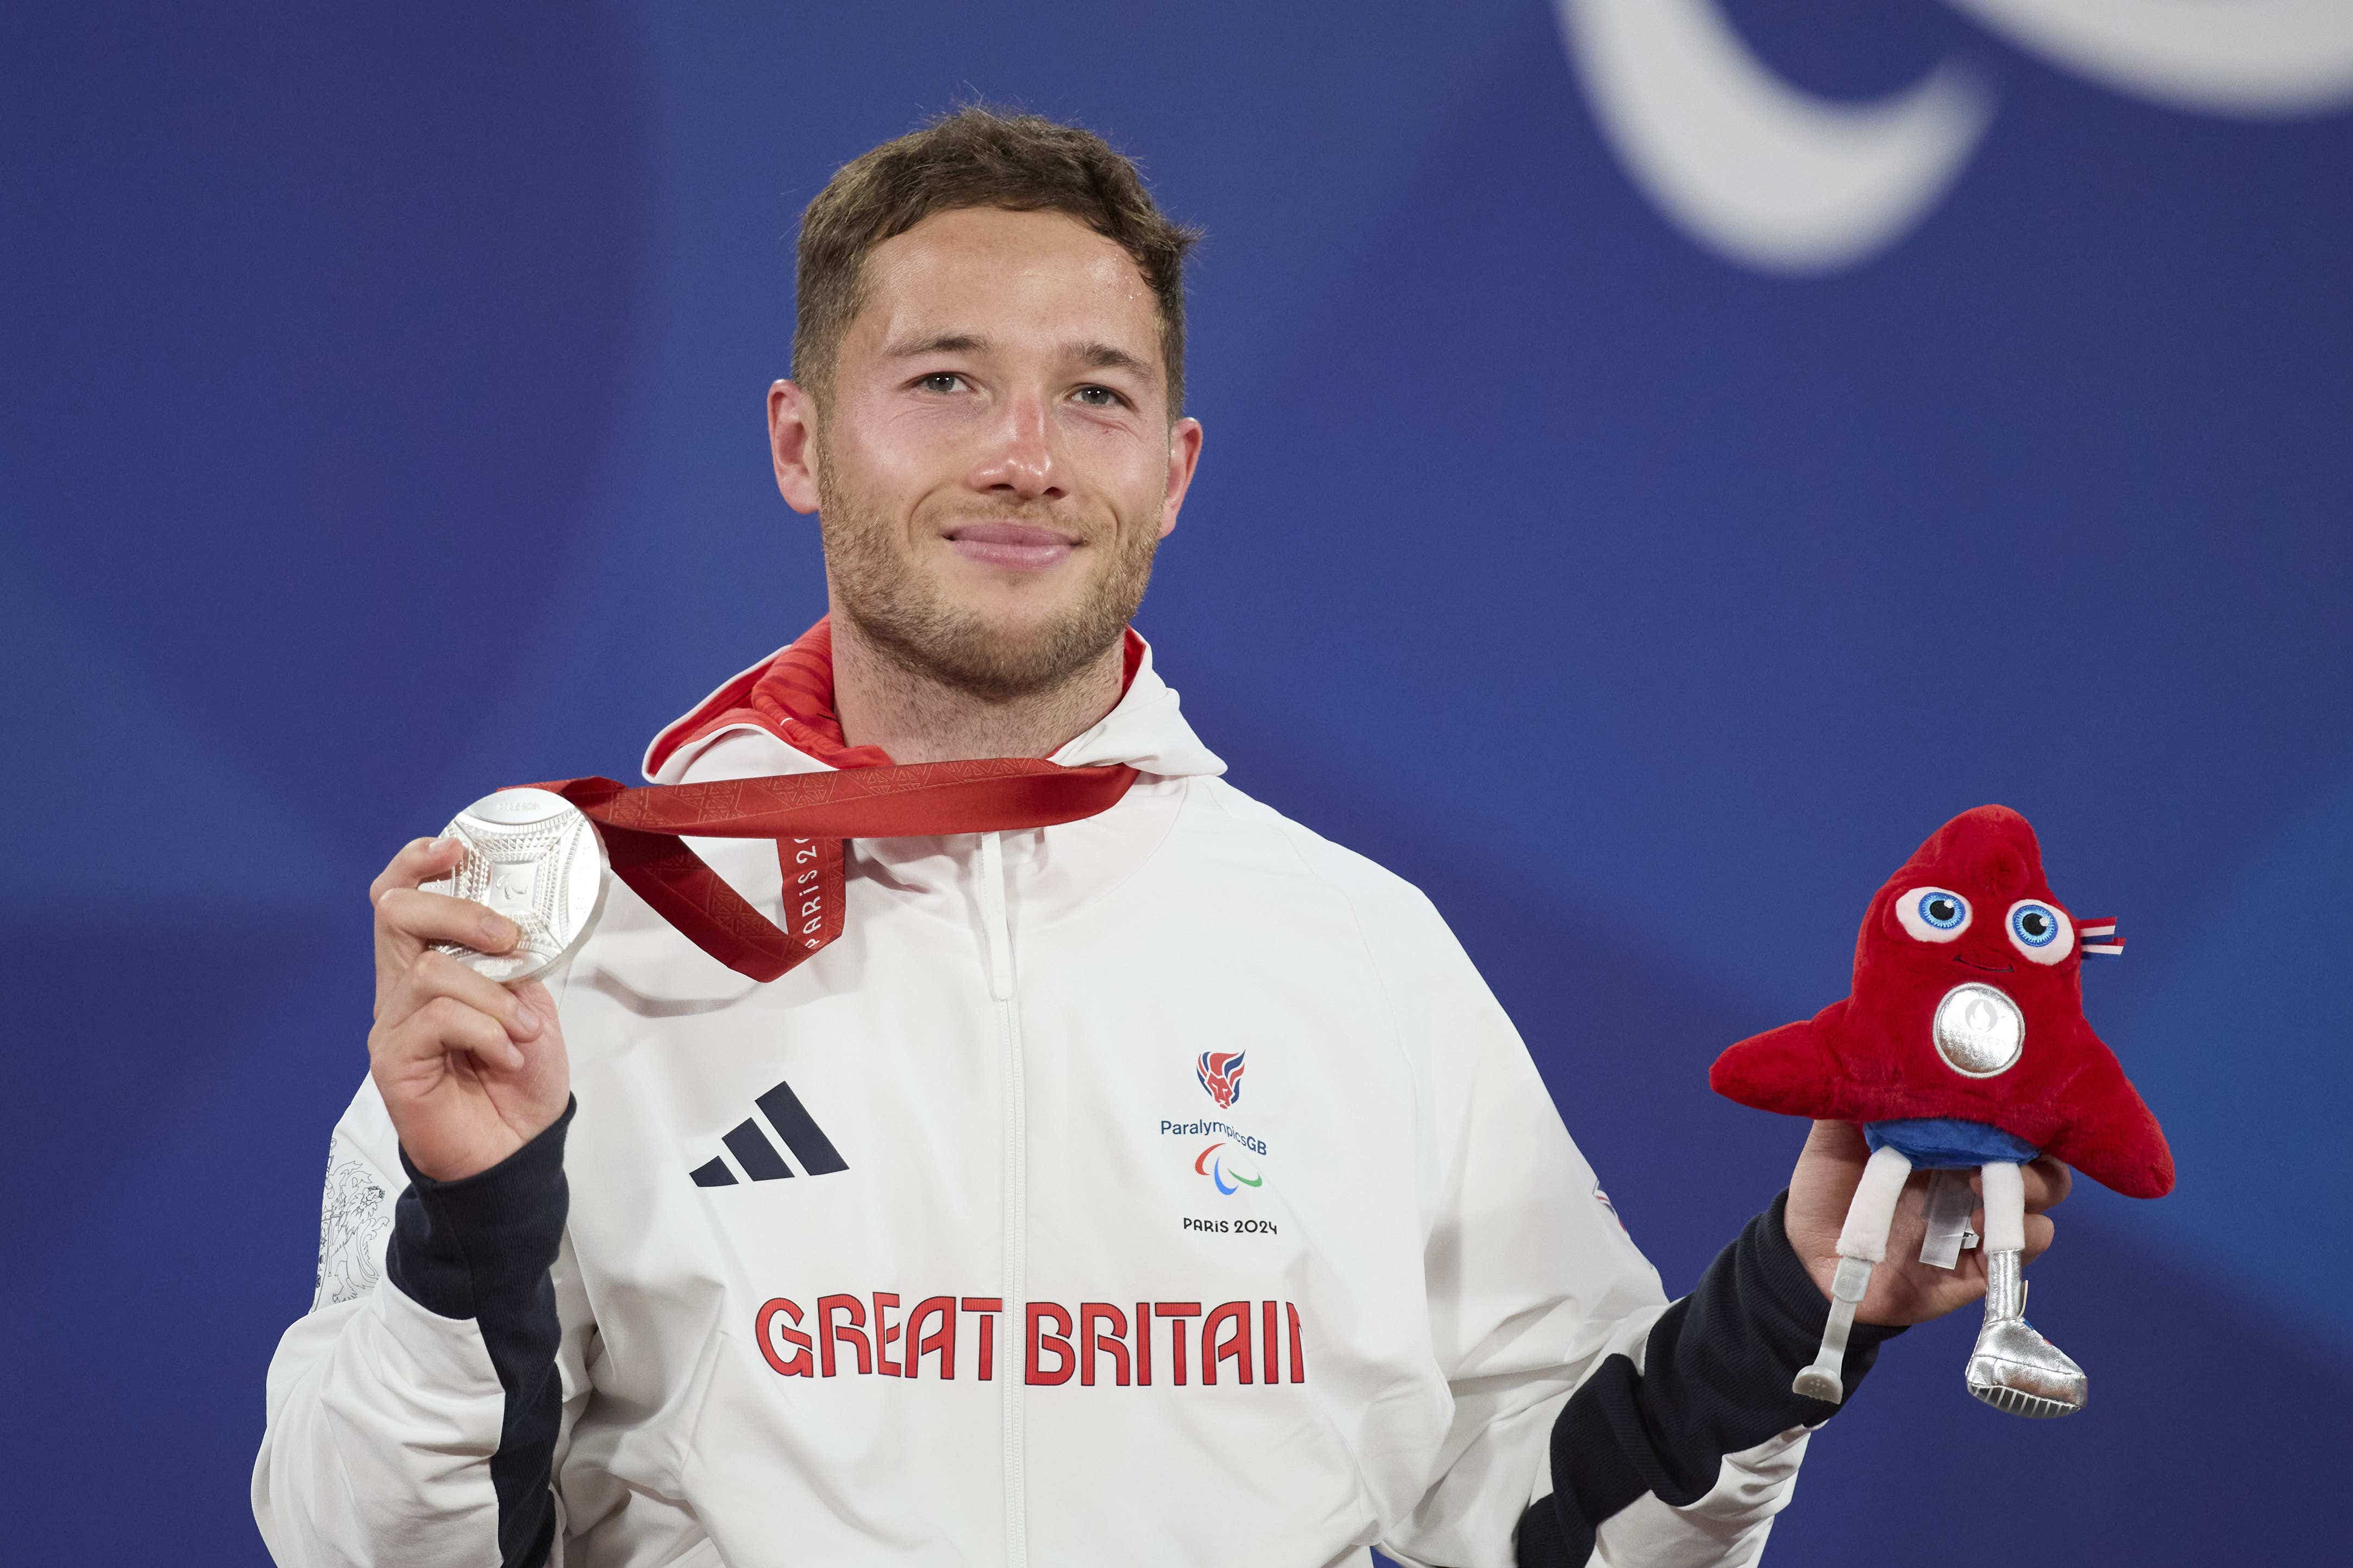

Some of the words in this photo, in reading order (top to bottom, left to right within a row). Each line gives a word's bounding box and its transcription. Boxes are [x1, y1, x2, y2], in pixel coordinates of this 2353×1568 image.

[794, 838, 817, 864] 2
[1160, 1119, 1267, 1156] ParalympicsGB
[1234, 1219, 1277, 1235] 2024
[755, 1292, 1002, 1381] GREAT
